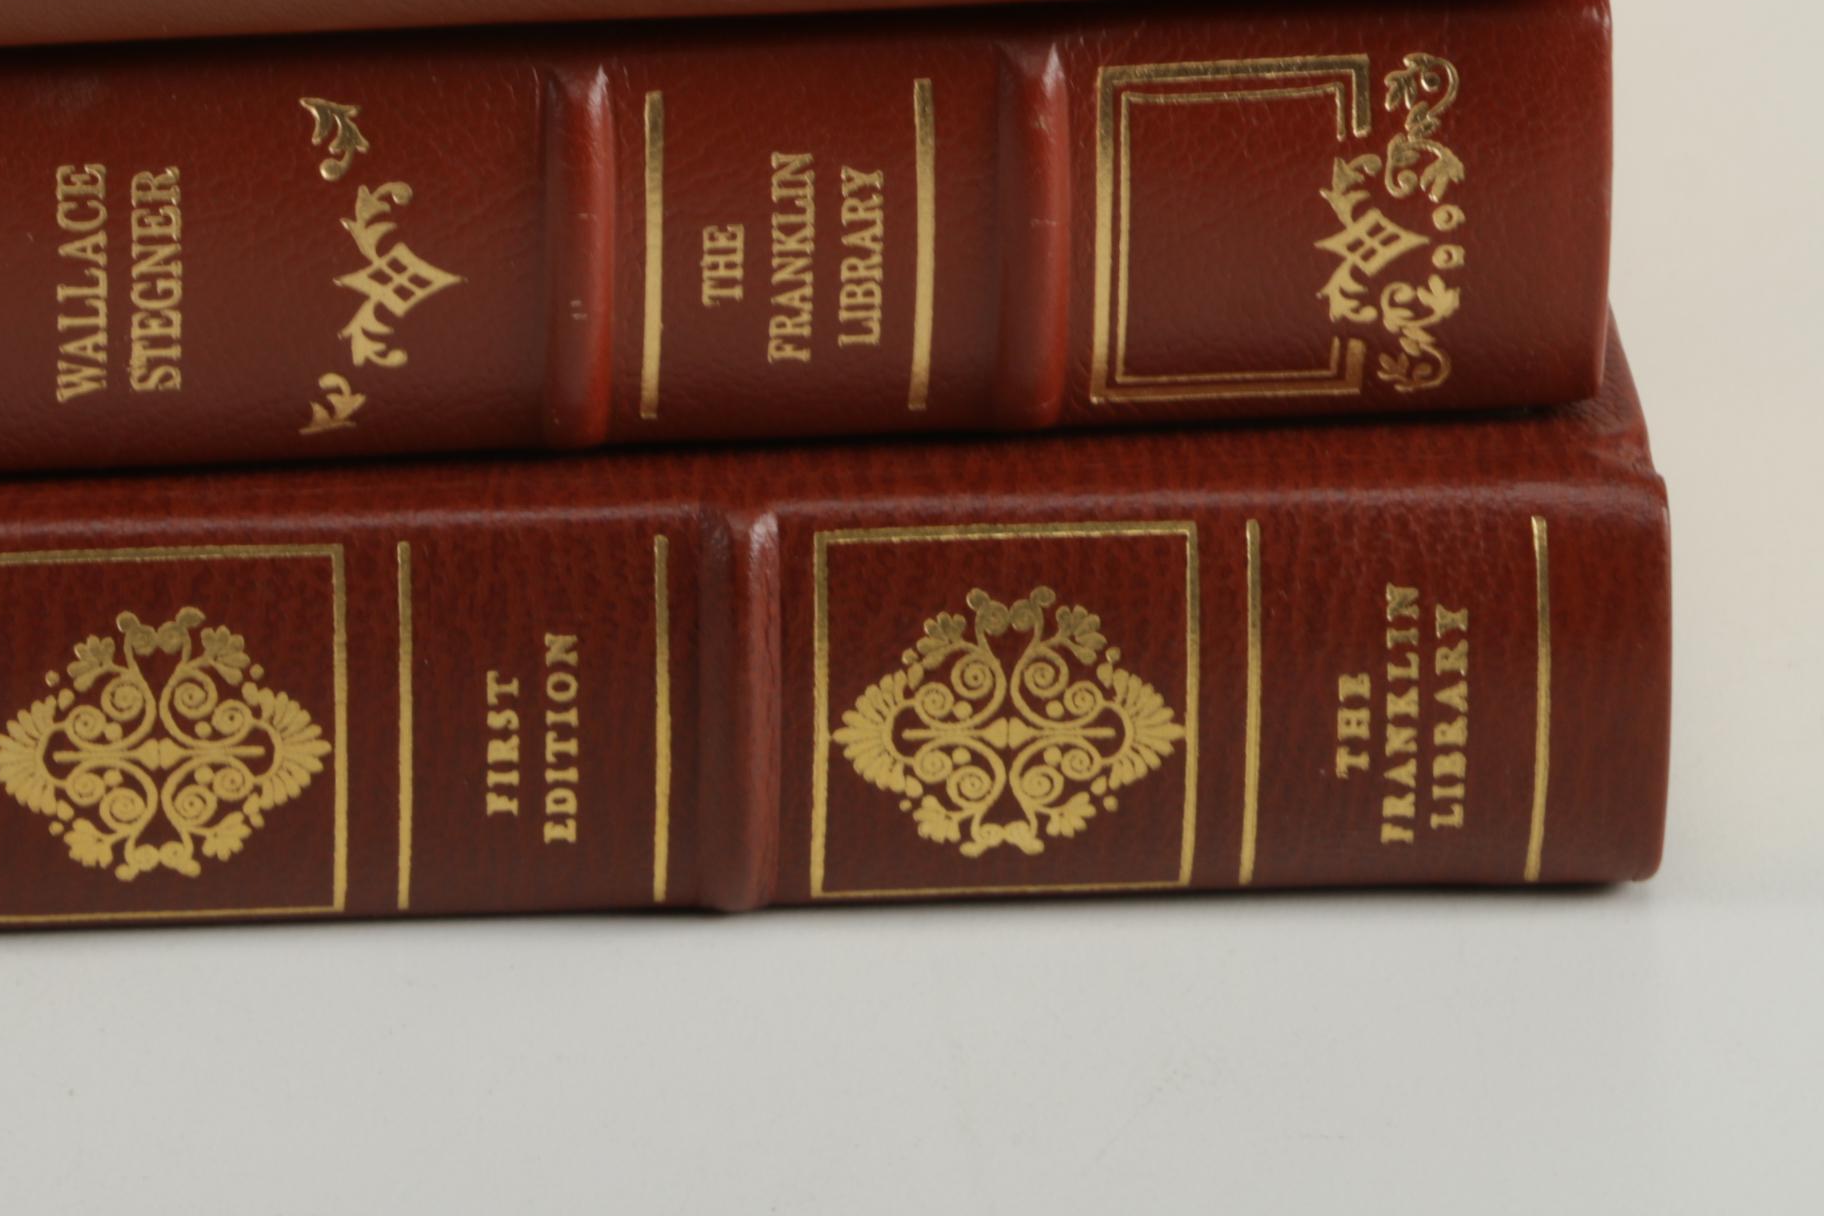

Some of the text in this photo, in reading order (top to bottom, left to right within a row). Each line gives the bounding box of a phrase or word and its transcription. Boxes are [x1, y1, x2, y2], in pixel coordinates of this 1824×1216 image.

[55, 163, 108, 403] WALLACE
[127, 165, 183, 392] STEGNER
[699, 223, 745, 307] THE
[767, 151, 816, 364] FRANKLIN
[837, 165, 885, 347] LIBRARY
[485, 670, 520, 816] FIRST
[543, 632, 579, 844] EDITION
[1335, 672, 1372, 779] THE
[1380, 582, 1420, 844] FRANKLIN
[1429, 603, 1469, 830] LIBRARY
